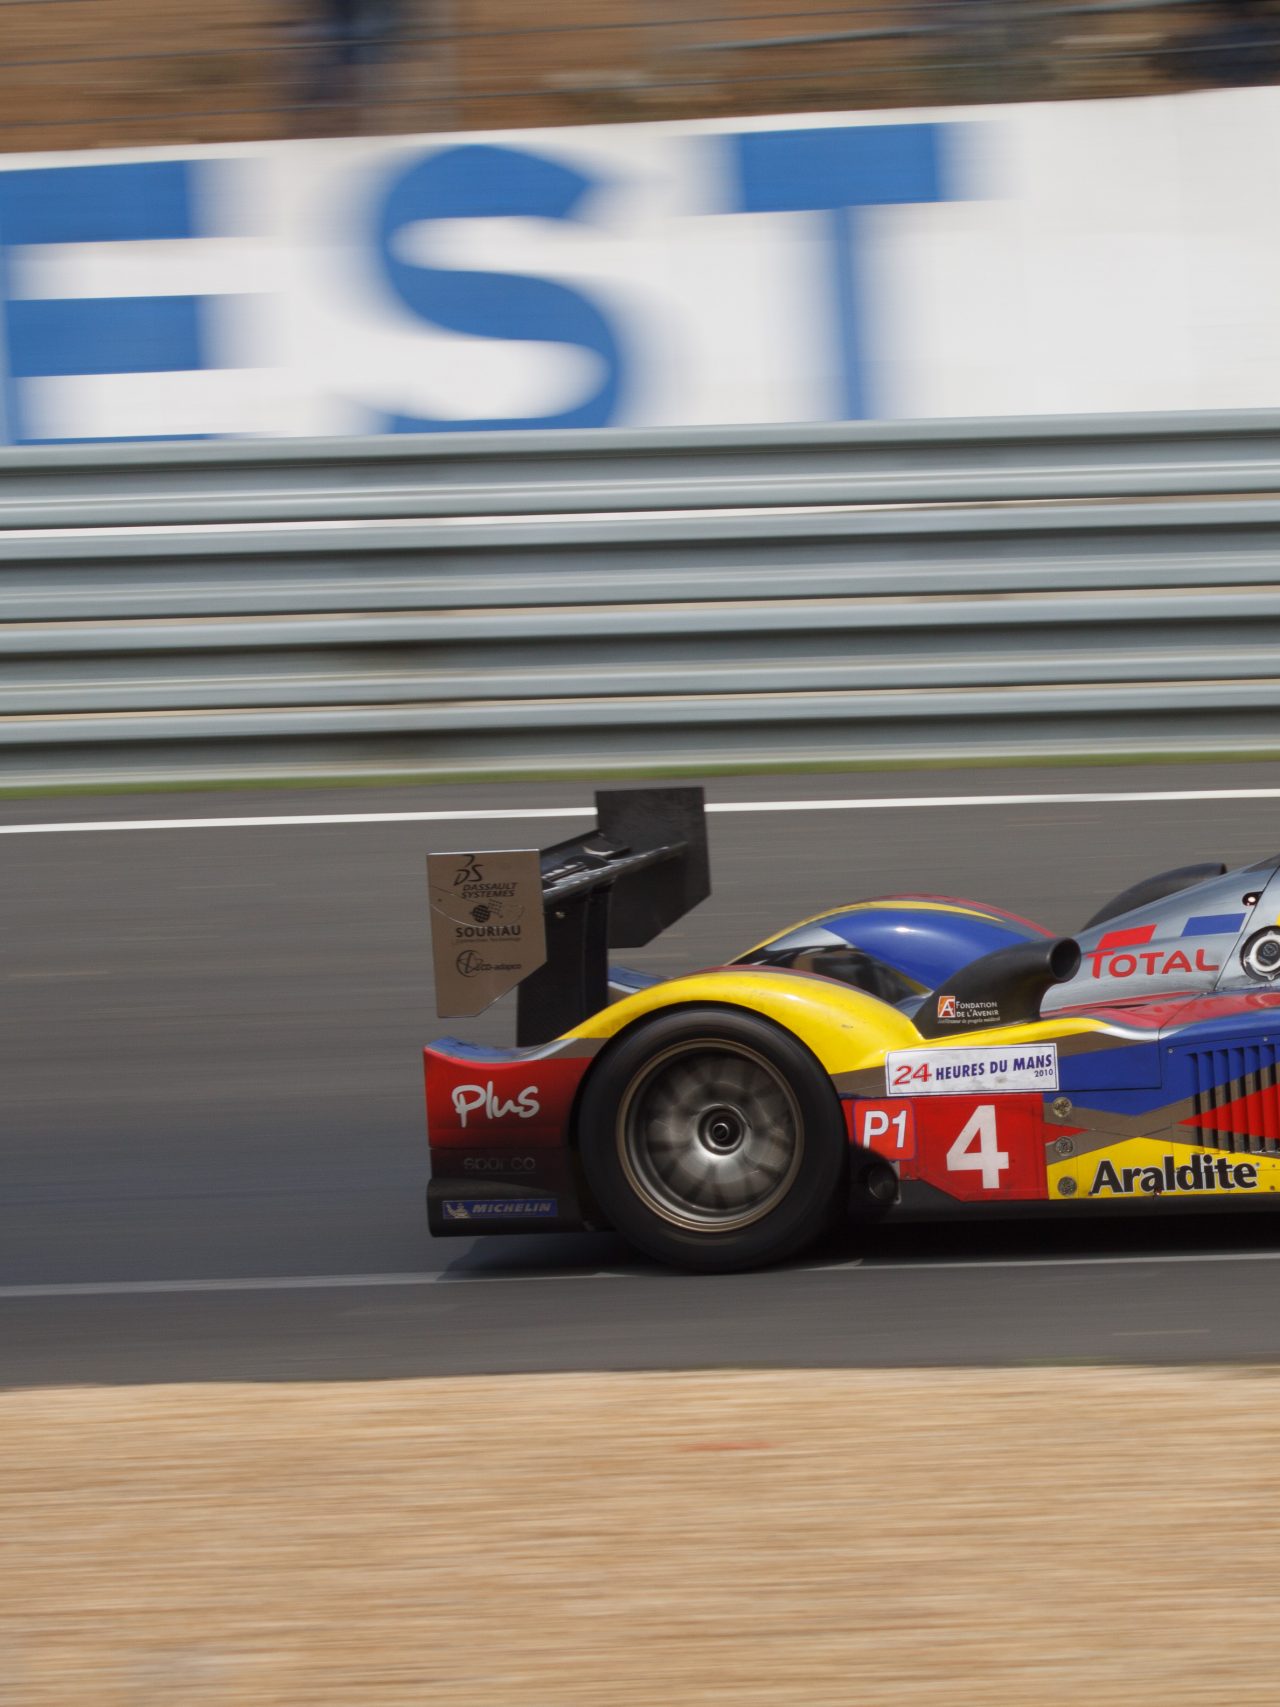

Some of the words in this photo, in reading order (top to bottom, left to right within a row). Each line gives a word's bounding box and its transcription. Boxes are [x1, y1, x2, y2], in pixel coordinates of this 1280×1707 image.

[462, 882, 518, 891] DASSAULT
[456, 925, 521, 938] SOURIAU
[892, 1062, 933, 1086] 24
[936, 1062, 985, 1080] HEURES
[989, 1059, 1008, 1073] DU
[1013, 1054, 1053, 1071] MANS
[1034, 1068, 1054, 1078] 2010
[452, 1081, 540, 1128] Plus
[863, 1109, 908, 1148] P1
[946, 1104, 1010, 1189] 4
[1091, 1154, 1259, 1194] Araldite
[472, 1203, 551, 1213] MICHELIN
